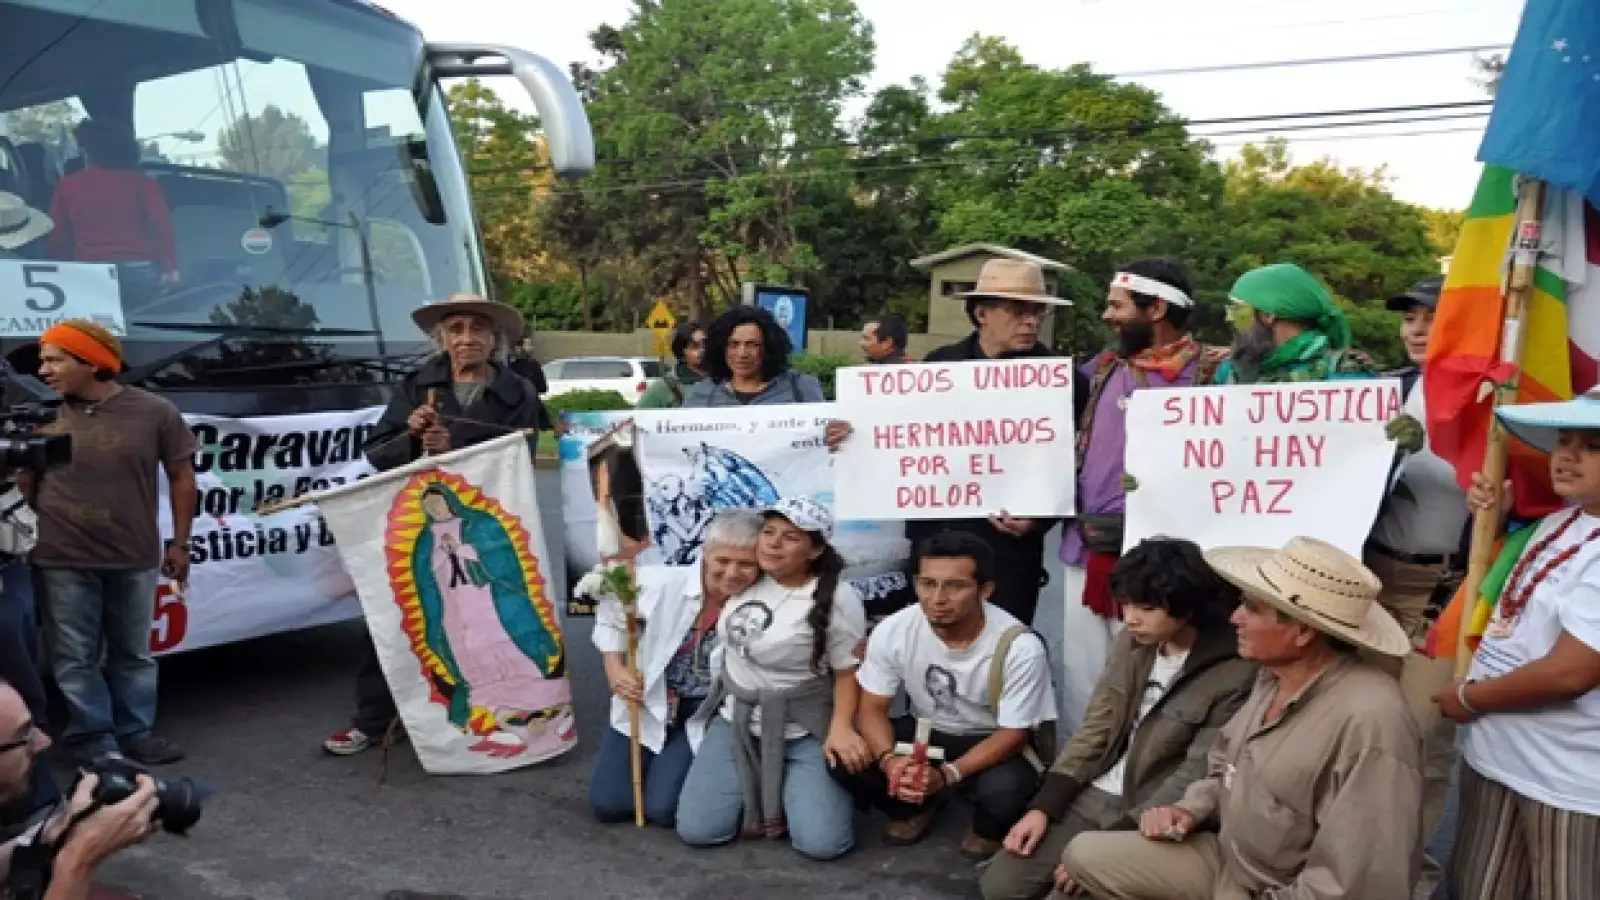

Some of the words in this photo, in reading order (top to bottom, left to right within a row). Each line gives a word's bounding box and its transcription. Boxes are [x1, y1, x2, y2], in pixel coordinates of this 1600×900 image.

[22, 264, 66, 312] 5
[859, 368, 954, 395] TODOS
[973, 363, 1069, 390] UNIDOS
[1162, 394, 1225, 426] SIN
[1247, 386, 1401, 424] JUSTICIA
[873, 416, 1057, 449] HERMANADOS
[899, 454, 950, 477] POR
[968, 453, 1004, 475] EL
[1183, 438, 1224, 468] NO
[1255, 434, 1326, 468] HAY
[896, 481, 983, 508] DOLOR
[1210, 479, 1294, 514] PAZ
[294, 522, 311, 554] y
[149, 584, 188, 652] 5
